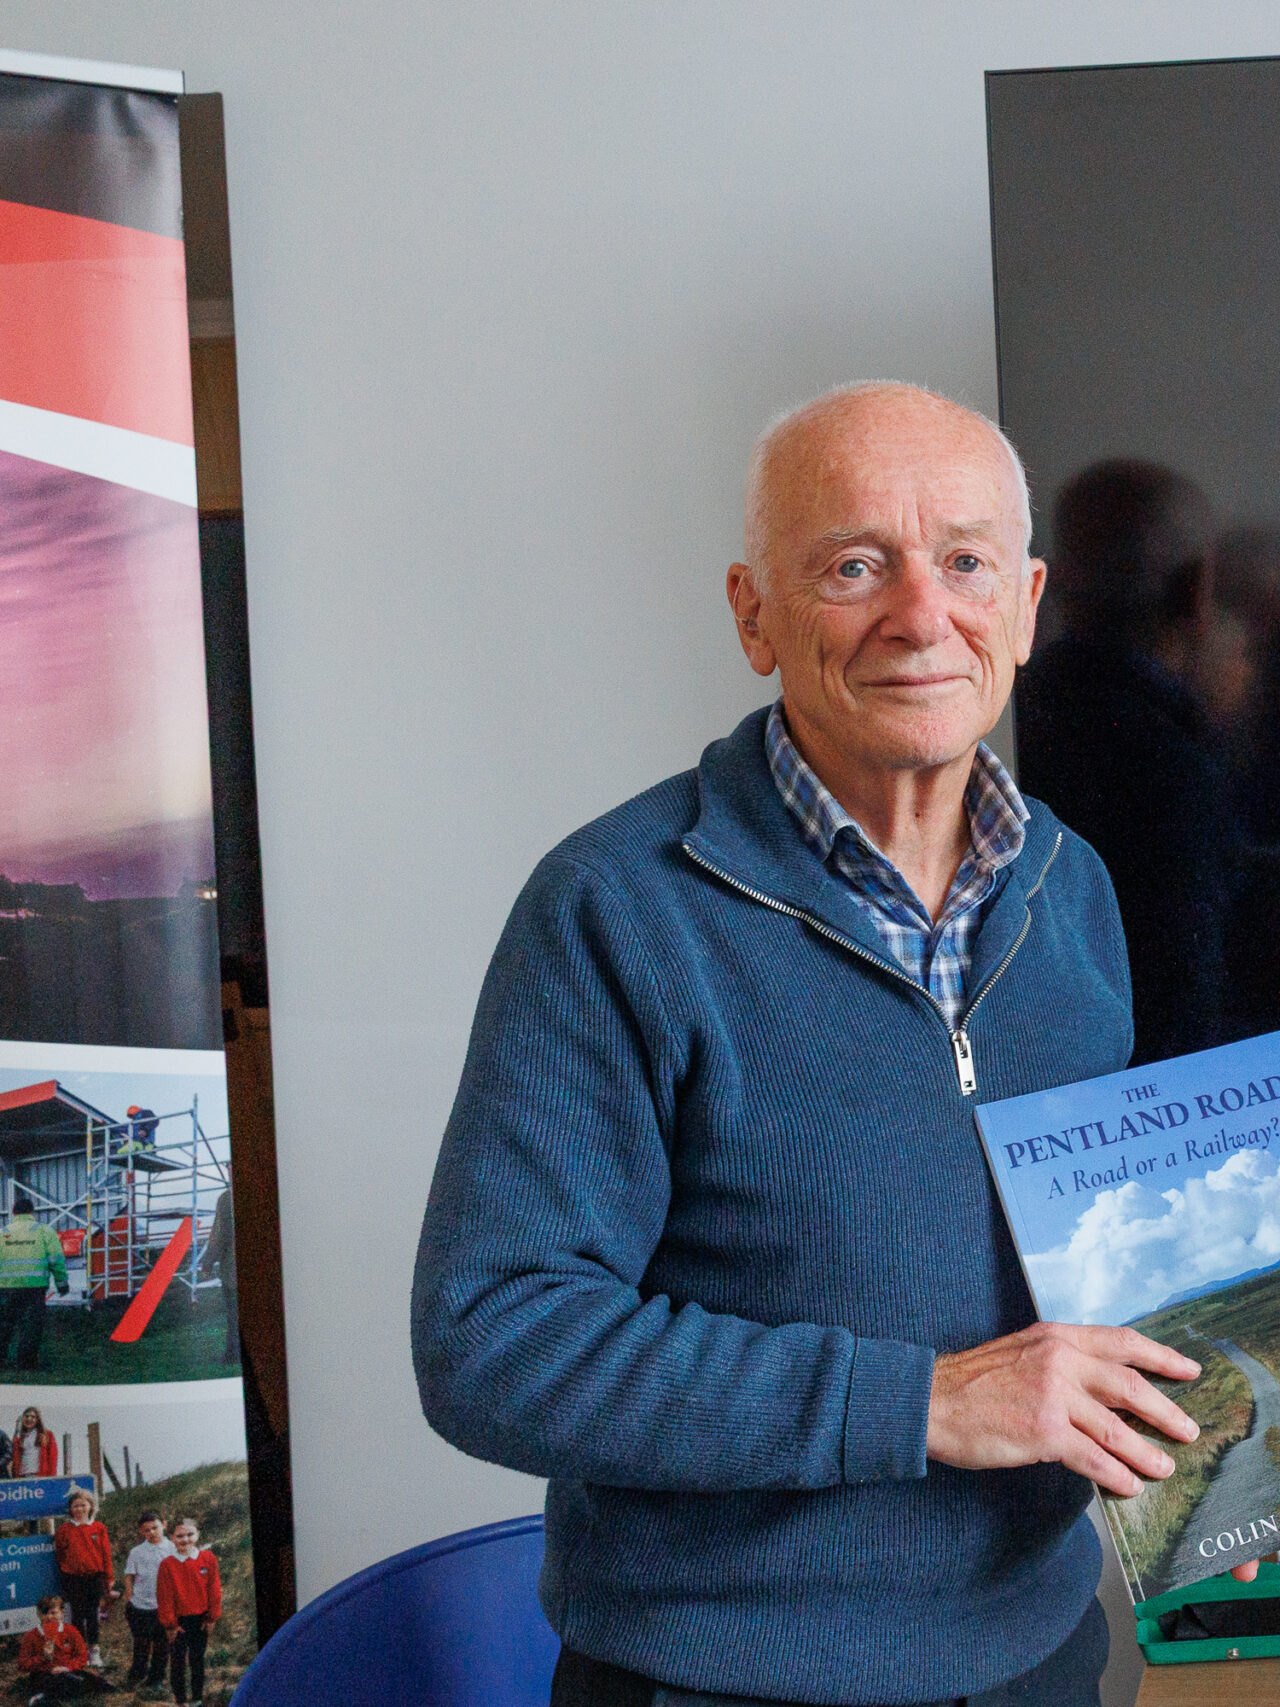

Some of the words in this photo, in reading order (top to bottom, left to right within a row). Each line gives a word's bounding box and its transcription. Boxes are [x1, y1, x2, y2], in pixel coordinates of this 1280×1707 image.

[1121, 1083, 1160, 1103] THE
[1003, 1102, 1189, 1169] PENTLAND
[1048, 1176, 1065, 1199] A
[1072, 1155, 1129, 1192] Road
[1135, 1156, 1157, 1175] or
[1165, 1152, 1178, 1167] a
[1184, 1117, 1280, 1162] Railway?
[1199, 1514, 1279, 1558] COLIN
[7, 1583, 16, 1598] 1
